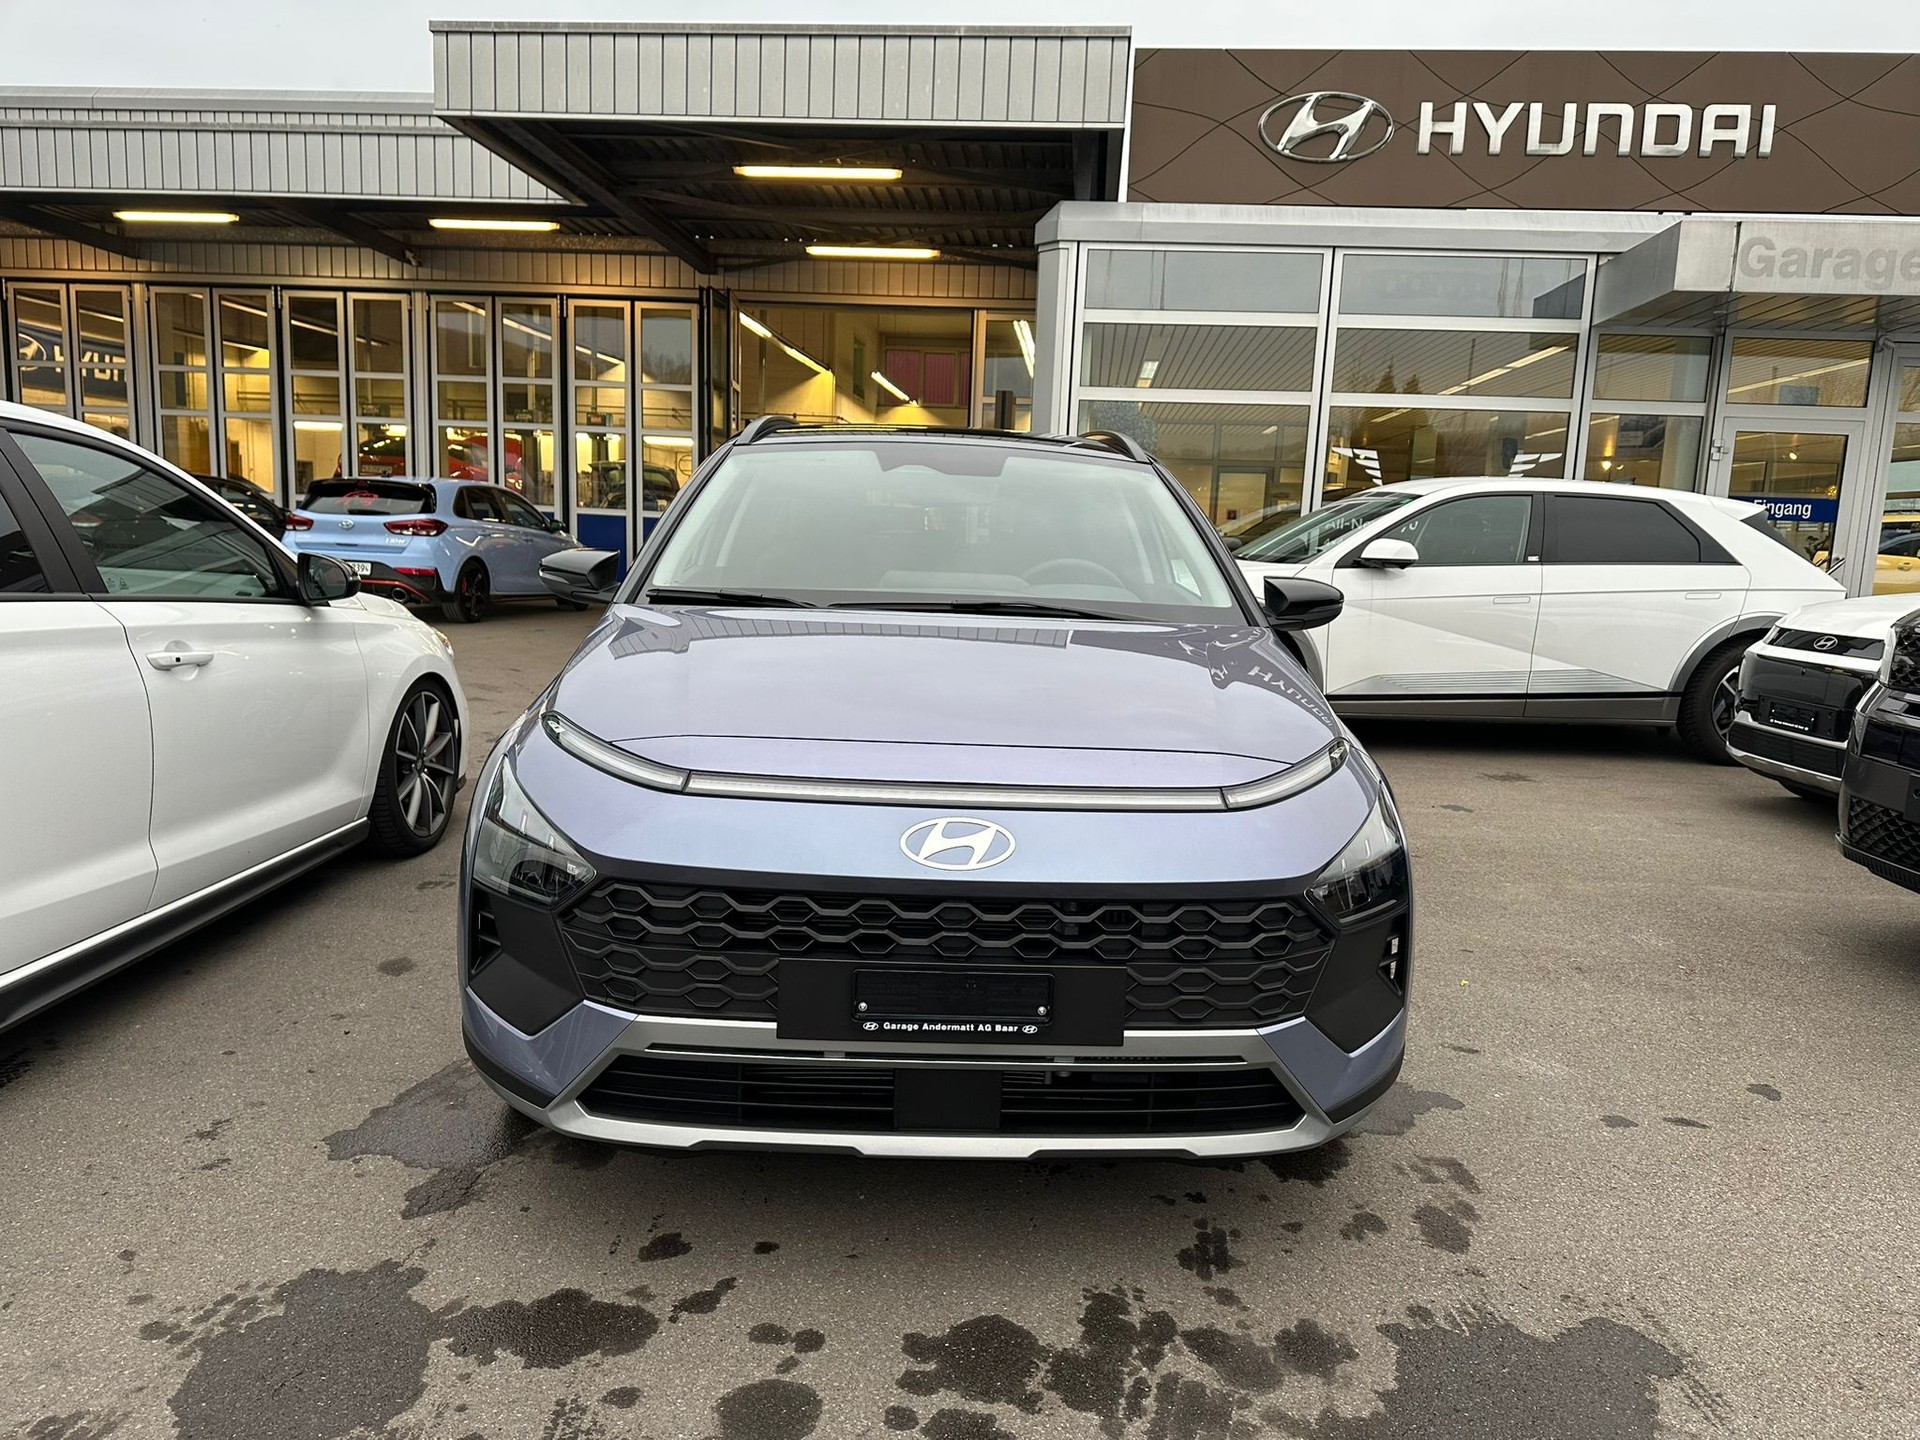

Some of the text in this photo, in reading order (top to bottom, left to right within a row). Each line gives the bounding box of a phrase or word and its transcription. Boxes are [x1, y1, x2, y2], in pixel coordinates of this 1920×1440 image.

[1416, 101, 1777, 158] HYUNDAI
[1739, 236, 1920, 291] Garage
[883, 1021, 1018, 1032] Garage Andermatt AG Baar
